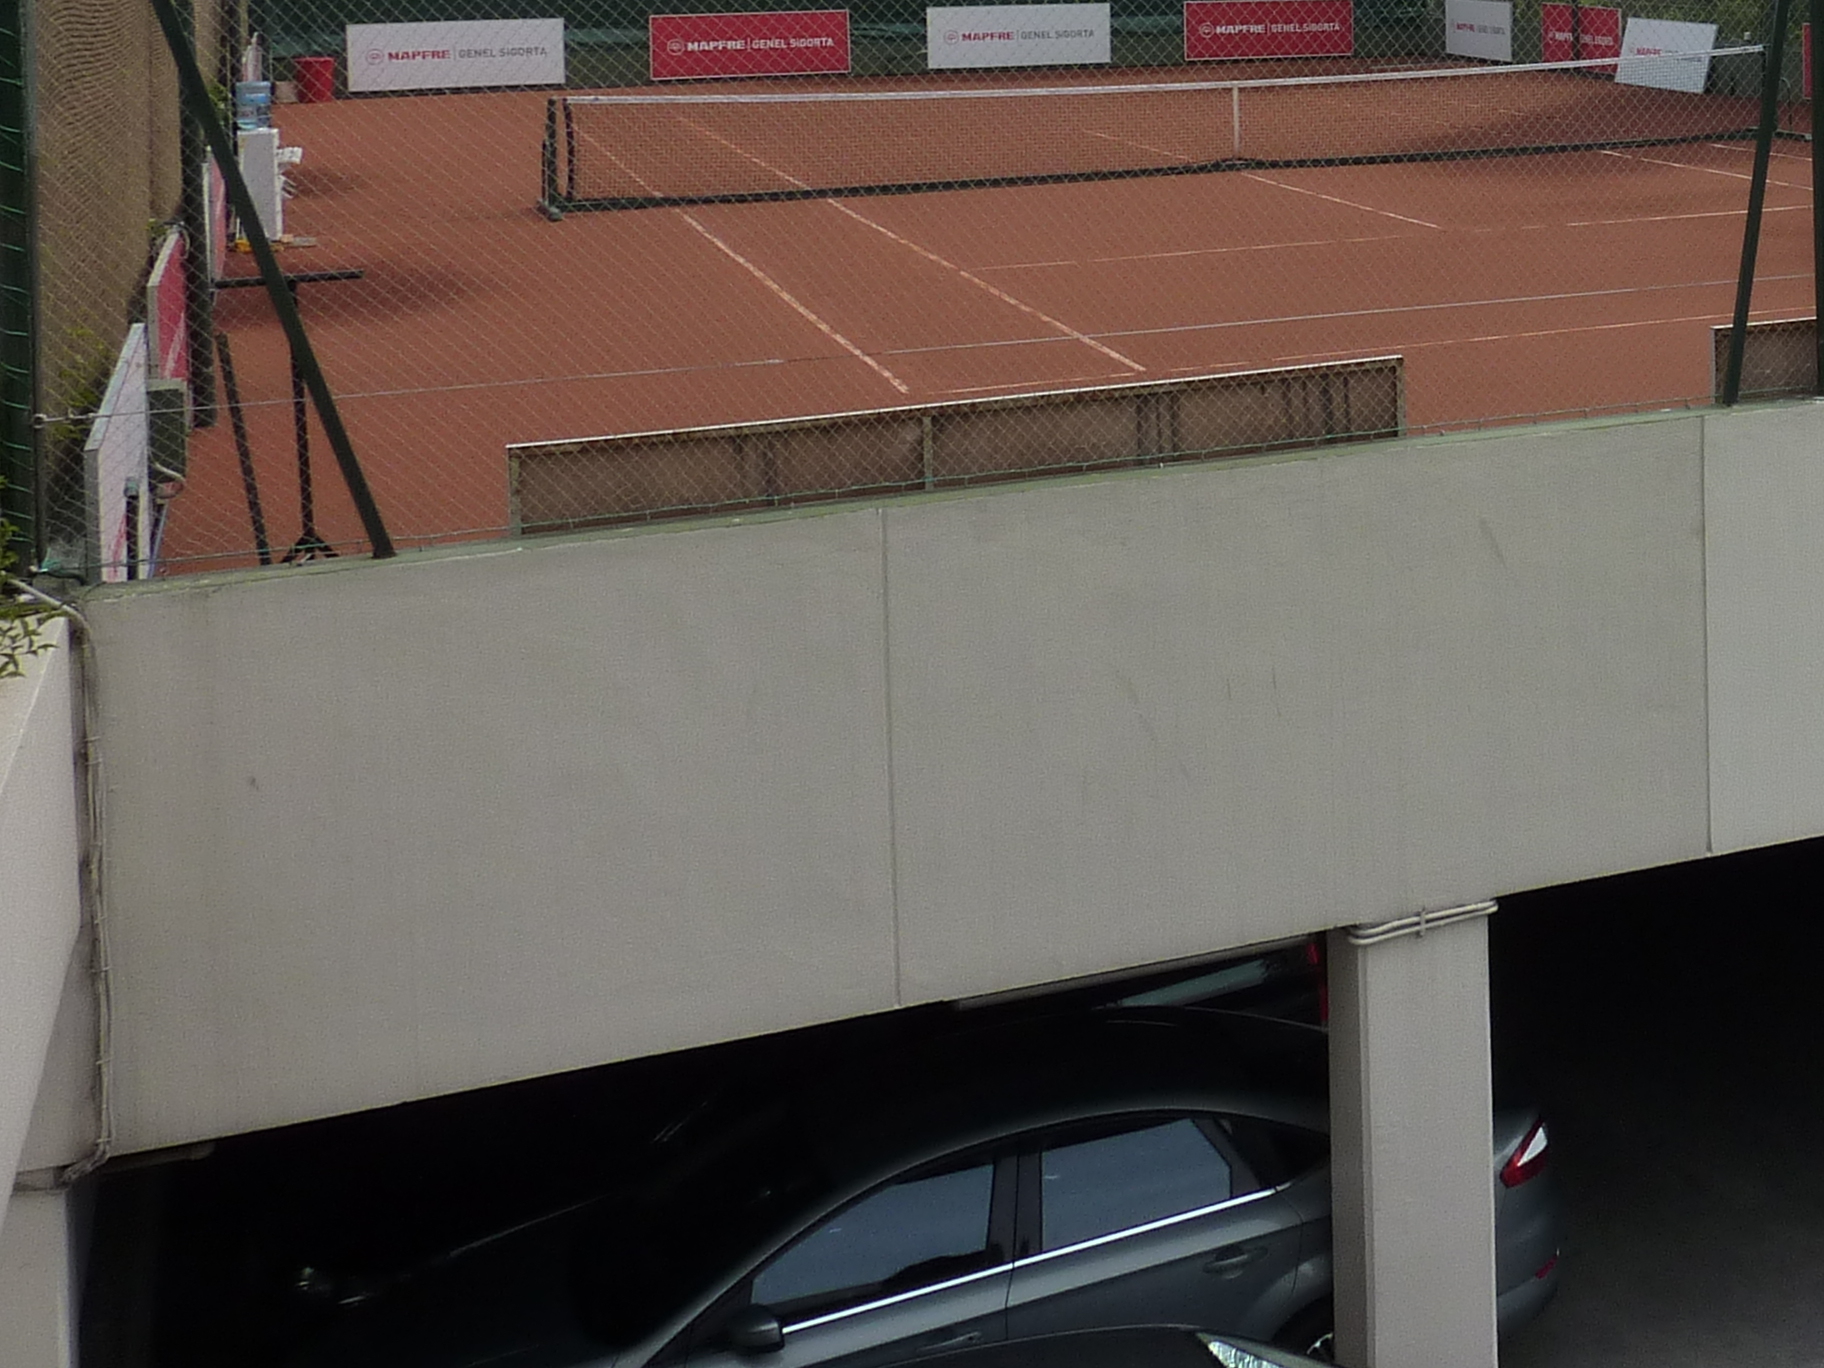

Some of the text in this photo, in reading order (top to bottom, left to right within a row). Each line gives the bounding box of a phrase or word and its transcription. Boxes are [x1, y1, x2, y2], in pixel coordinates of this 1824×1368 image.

[1216, 24, 1265, 34] MAPFRE
[1271, 23, 1301, 33] GENEL
[961, 31, 1014, 42] MAPFRE
[1021, 30, 1051, 40] GENEL
[687, 39, 746, 51] MAPFRE
[751, 38, 787, 49] GENEL
[387, 49, 450, 61] MAPFRE
[458, 48, 496, 59] GENEL
